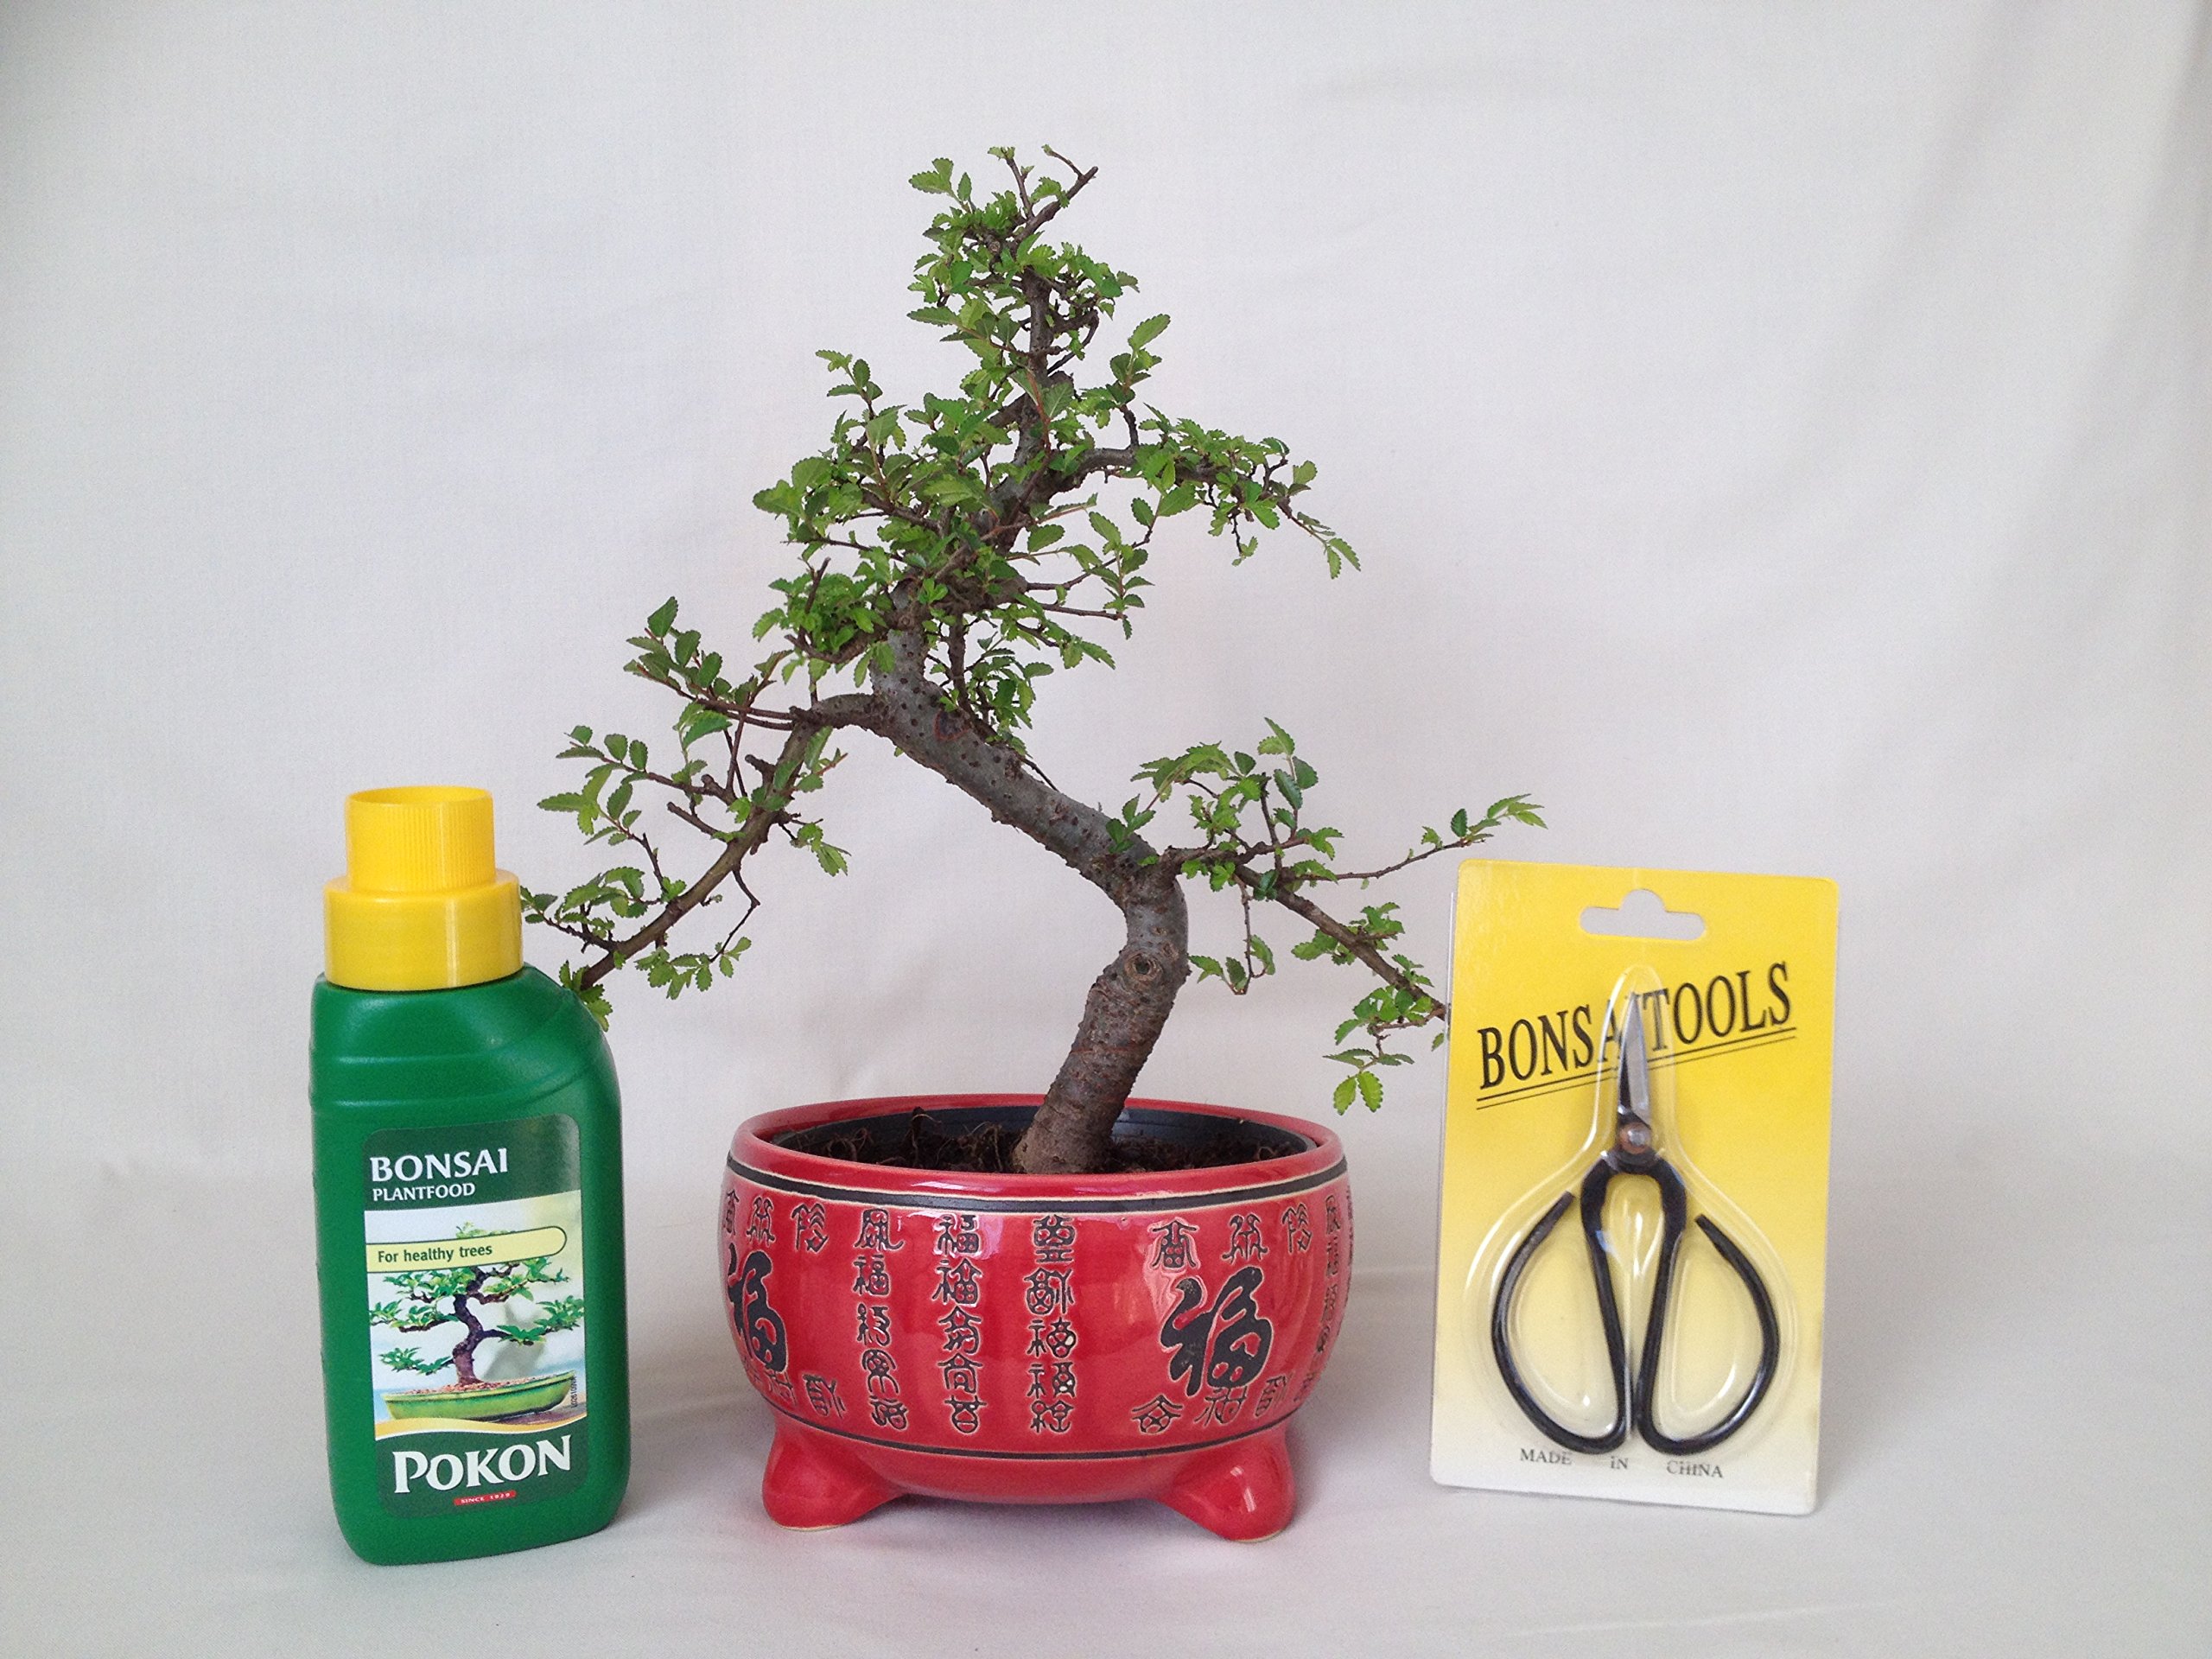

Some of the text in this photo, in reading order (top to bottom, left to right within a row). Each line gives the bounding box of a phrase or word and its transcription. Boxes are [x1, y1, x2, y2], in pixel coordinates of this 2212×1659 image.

[1477, 960, 1792, 1090] BONSA TOOLS
[370, 1147, 508, 1182] BONSAI
[372, 1182, 476, 1202] PLANTFOOD
[378, 1244, 493, 1263] For healthy trees
[392, 1434, 572, 1494] POKON
[1520, 1448, 1573, 1465] MADE
[1666, 1460, 1725, 1478] CHINA
[460, 1496, 486, 1504] SINCE
